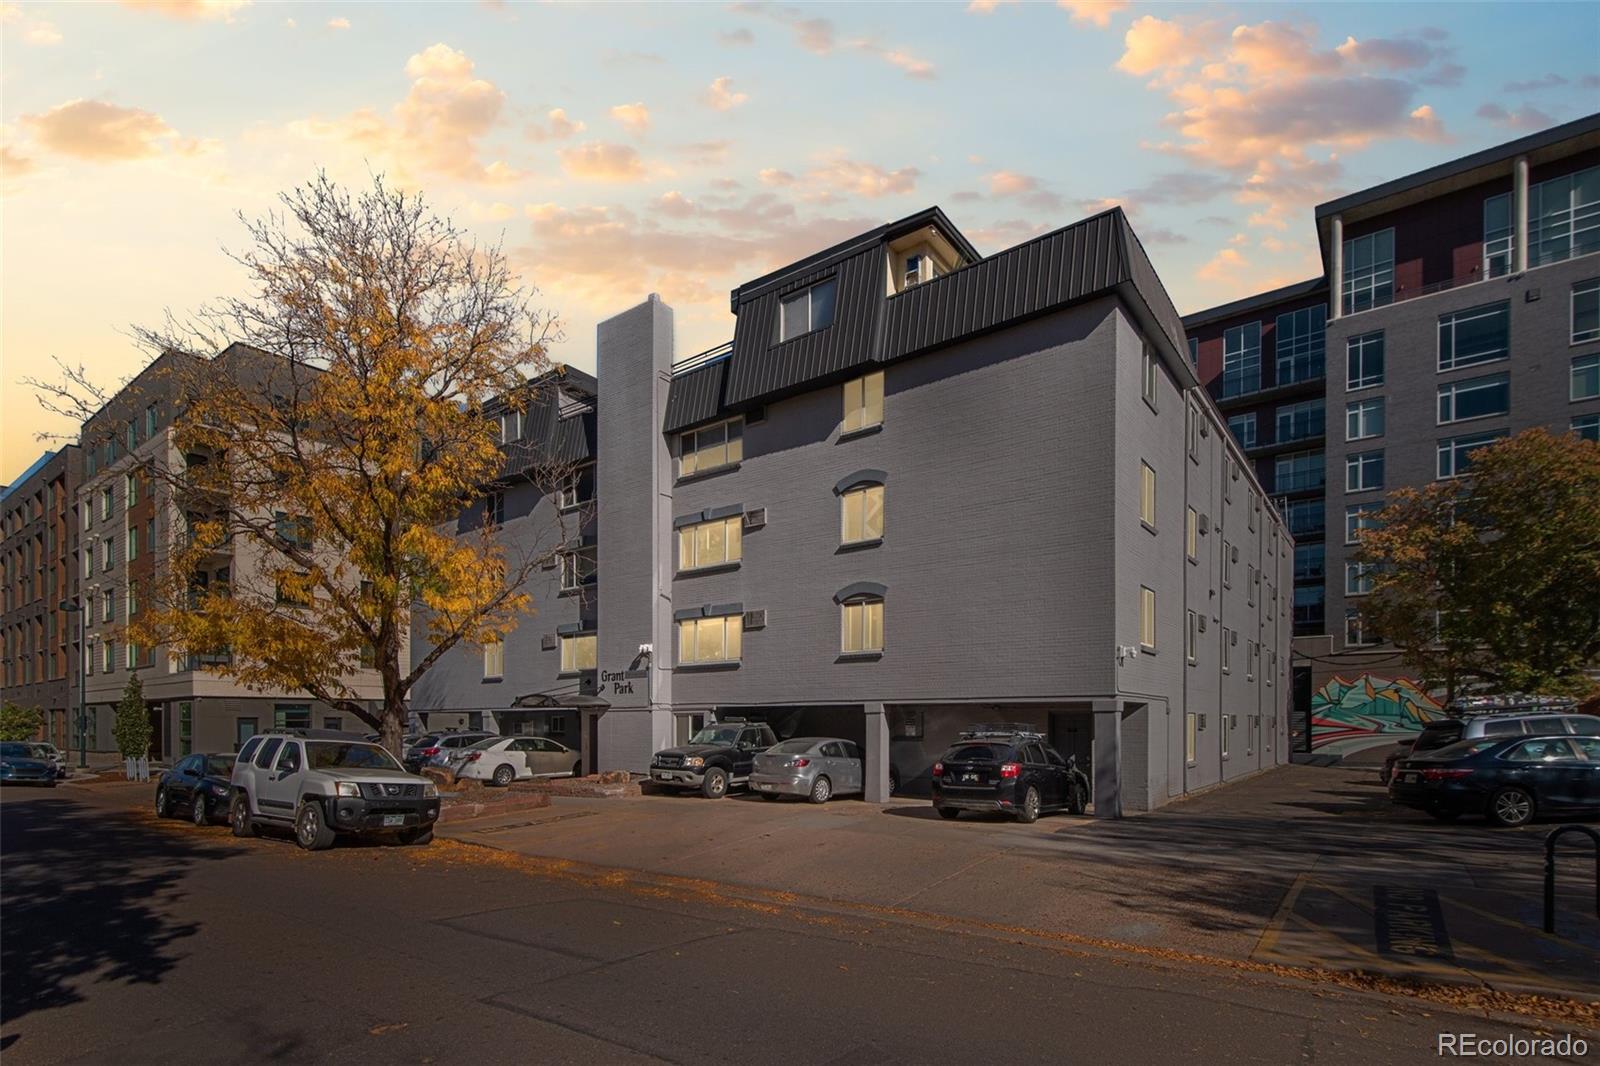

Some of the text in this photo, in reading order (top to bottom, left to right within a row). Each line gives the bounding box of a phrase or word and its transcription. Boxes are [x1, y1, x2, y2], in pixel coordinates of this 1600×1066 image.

[601, 670, 625, 682] Grant
[614, 681, 634, 694] Park
[1386, 903, 1440, 955] PARKING
